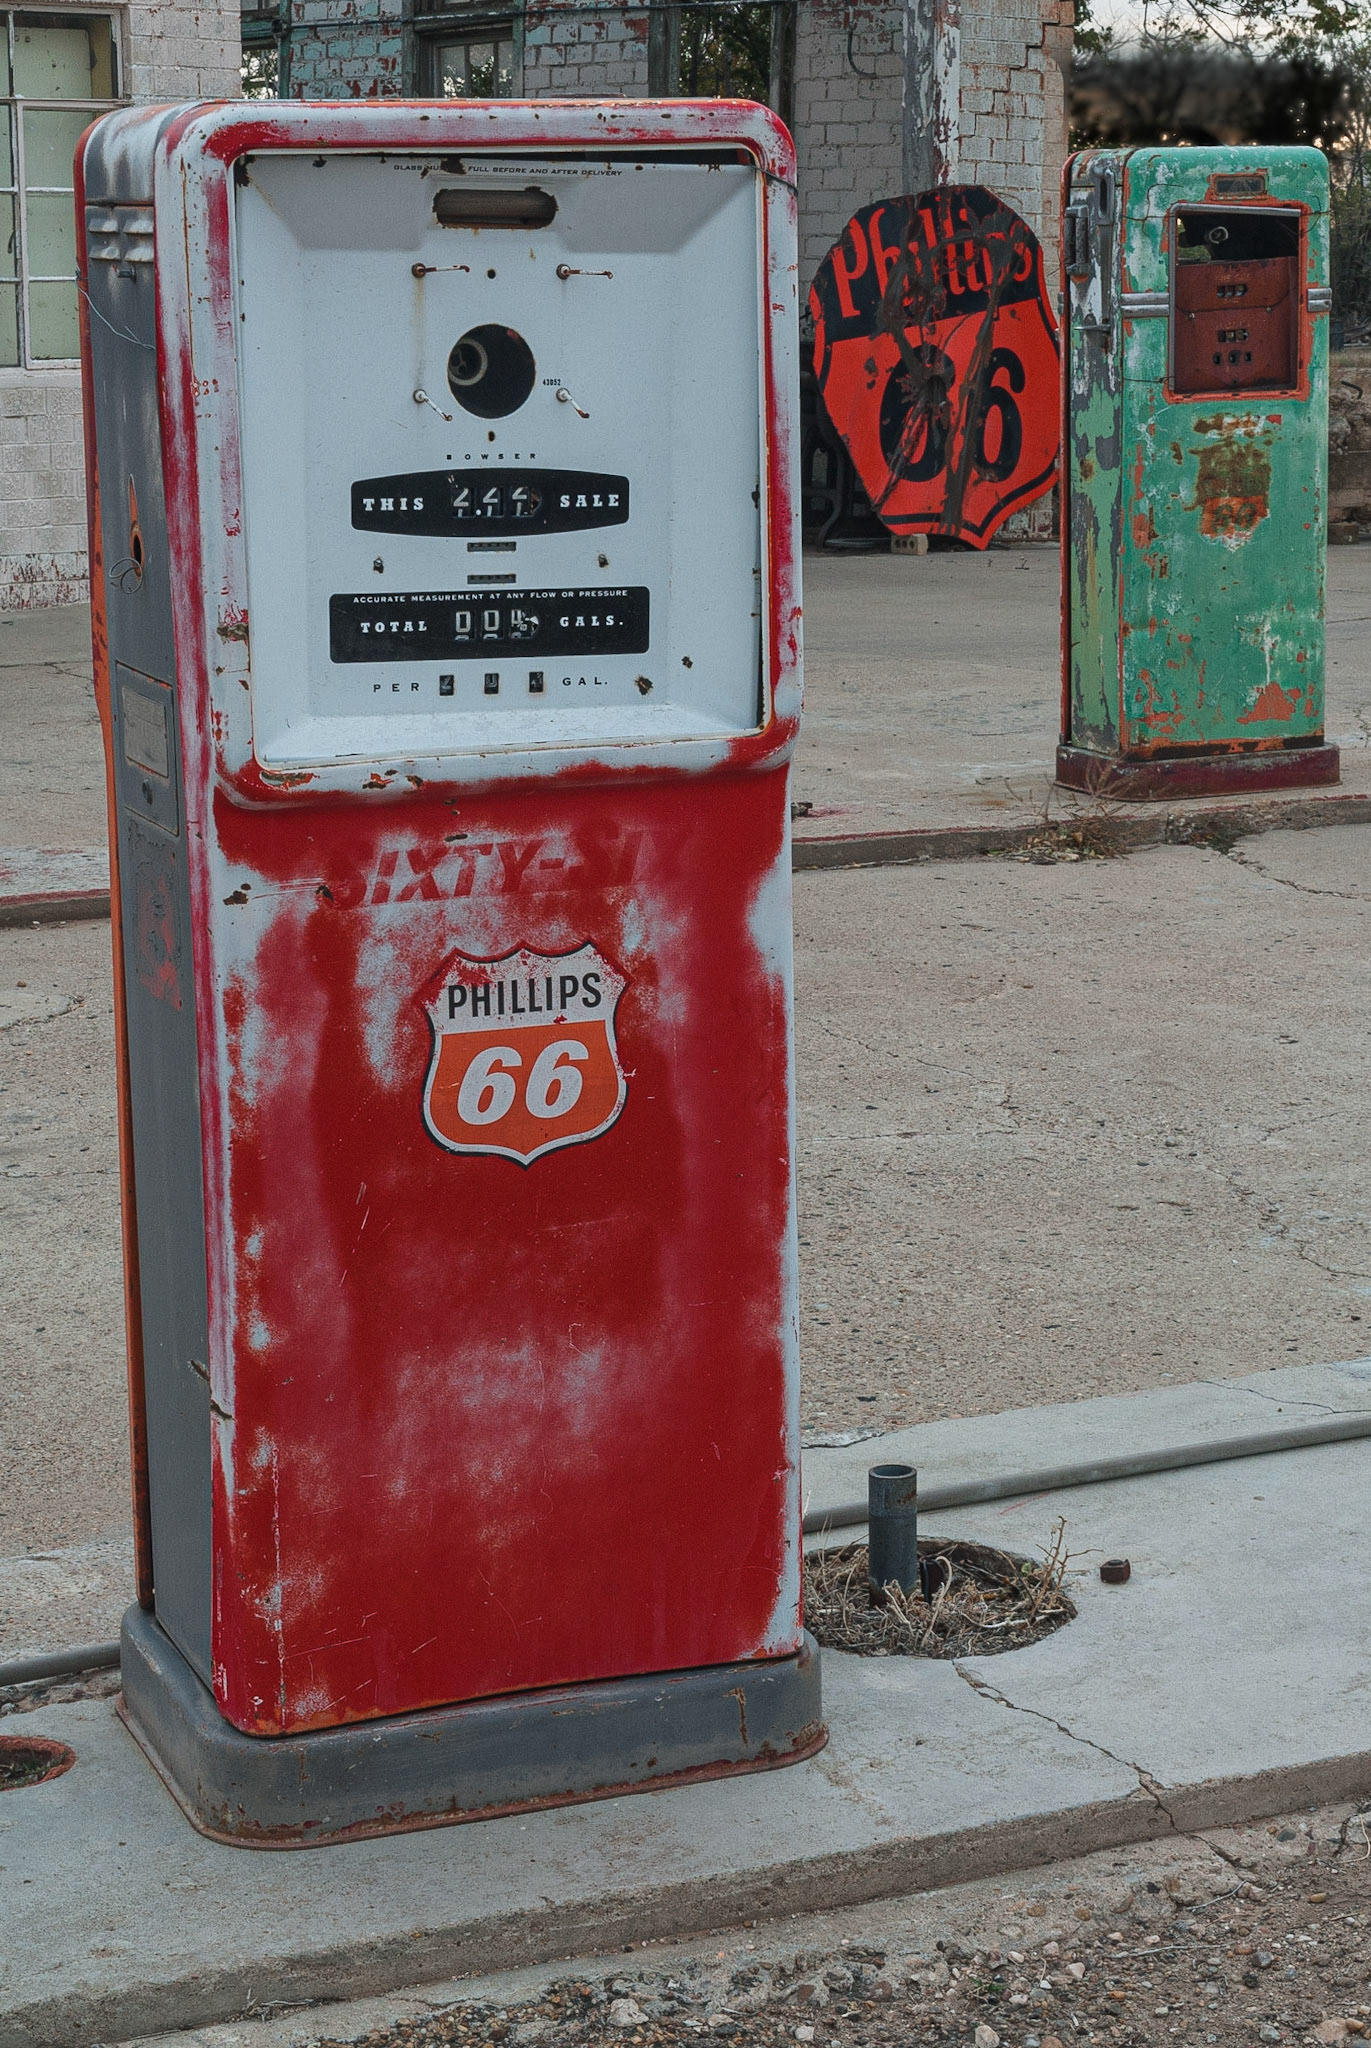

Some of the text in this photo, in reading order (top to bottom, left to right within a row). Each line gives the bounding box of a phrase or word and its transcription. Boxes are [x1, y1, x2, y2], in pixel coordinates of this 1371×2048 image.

[467, 165, 490, 173] FULL
[879, 344, 1026, 483] 66
[446, 453, 537, 461] BOWSER
[362, 497, 425, 511] THIS
[559, 494, 620, 508] SALE
[353, 595, 406, 604] ACCURATE
[410, 593, 485, 602] MEASUREMENT
[561, 590, 574, 598] OR
[579, 589, 628, 597] PRESSURE
[360, 620, 428, 633] TOTAL
[559, 614, 624, 628] GALS.
[372, 675, 609, 693] PER GAL.
[447, 971, 603, 1020] PHILLIPS
[456, 1039, 590, 1127] 66
